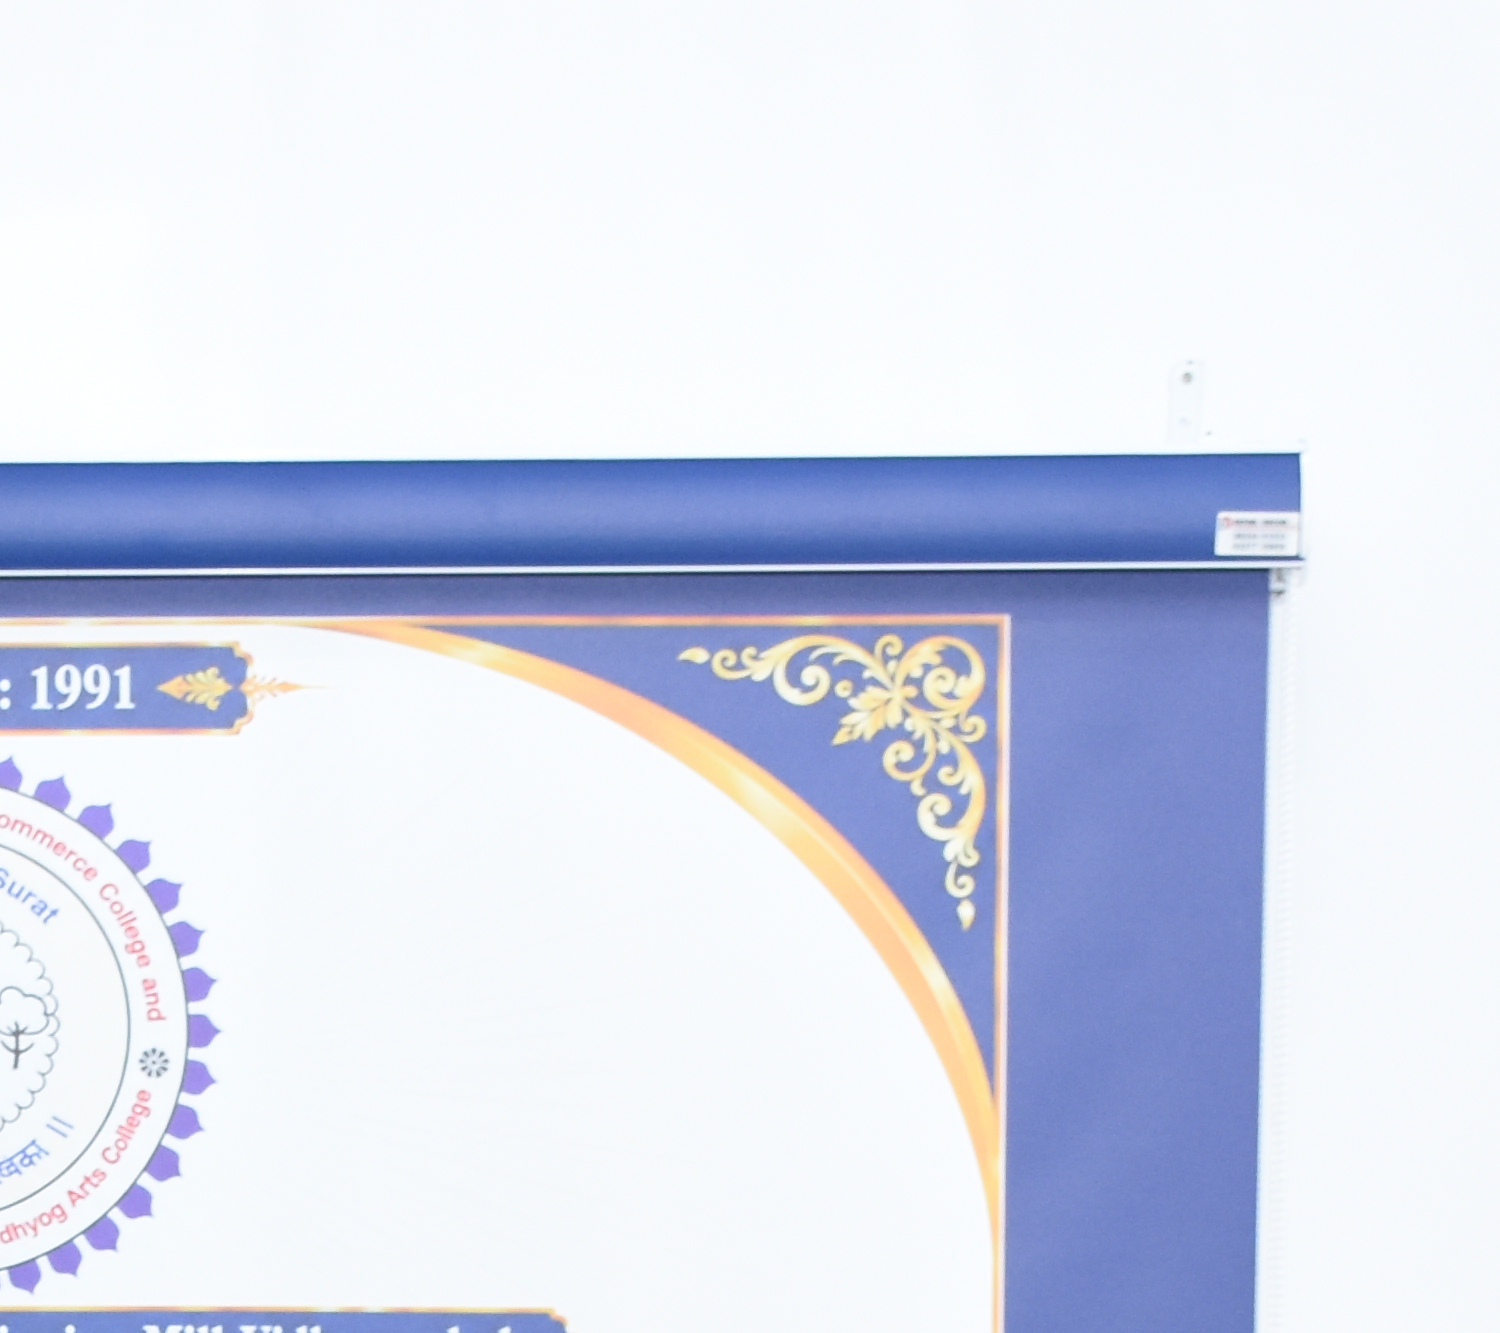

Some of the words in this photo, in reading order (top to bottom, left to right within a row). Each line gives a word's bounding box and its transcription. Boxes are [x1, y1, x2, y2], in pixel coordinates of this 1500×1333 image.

[31, 664, 135, 709] 1991
[99, 882, 151, 968] College
[142, 977, 166, 1022] and
[65, 1167, 108, 1206] Arts
[102, 1088, 153, 1163] College
